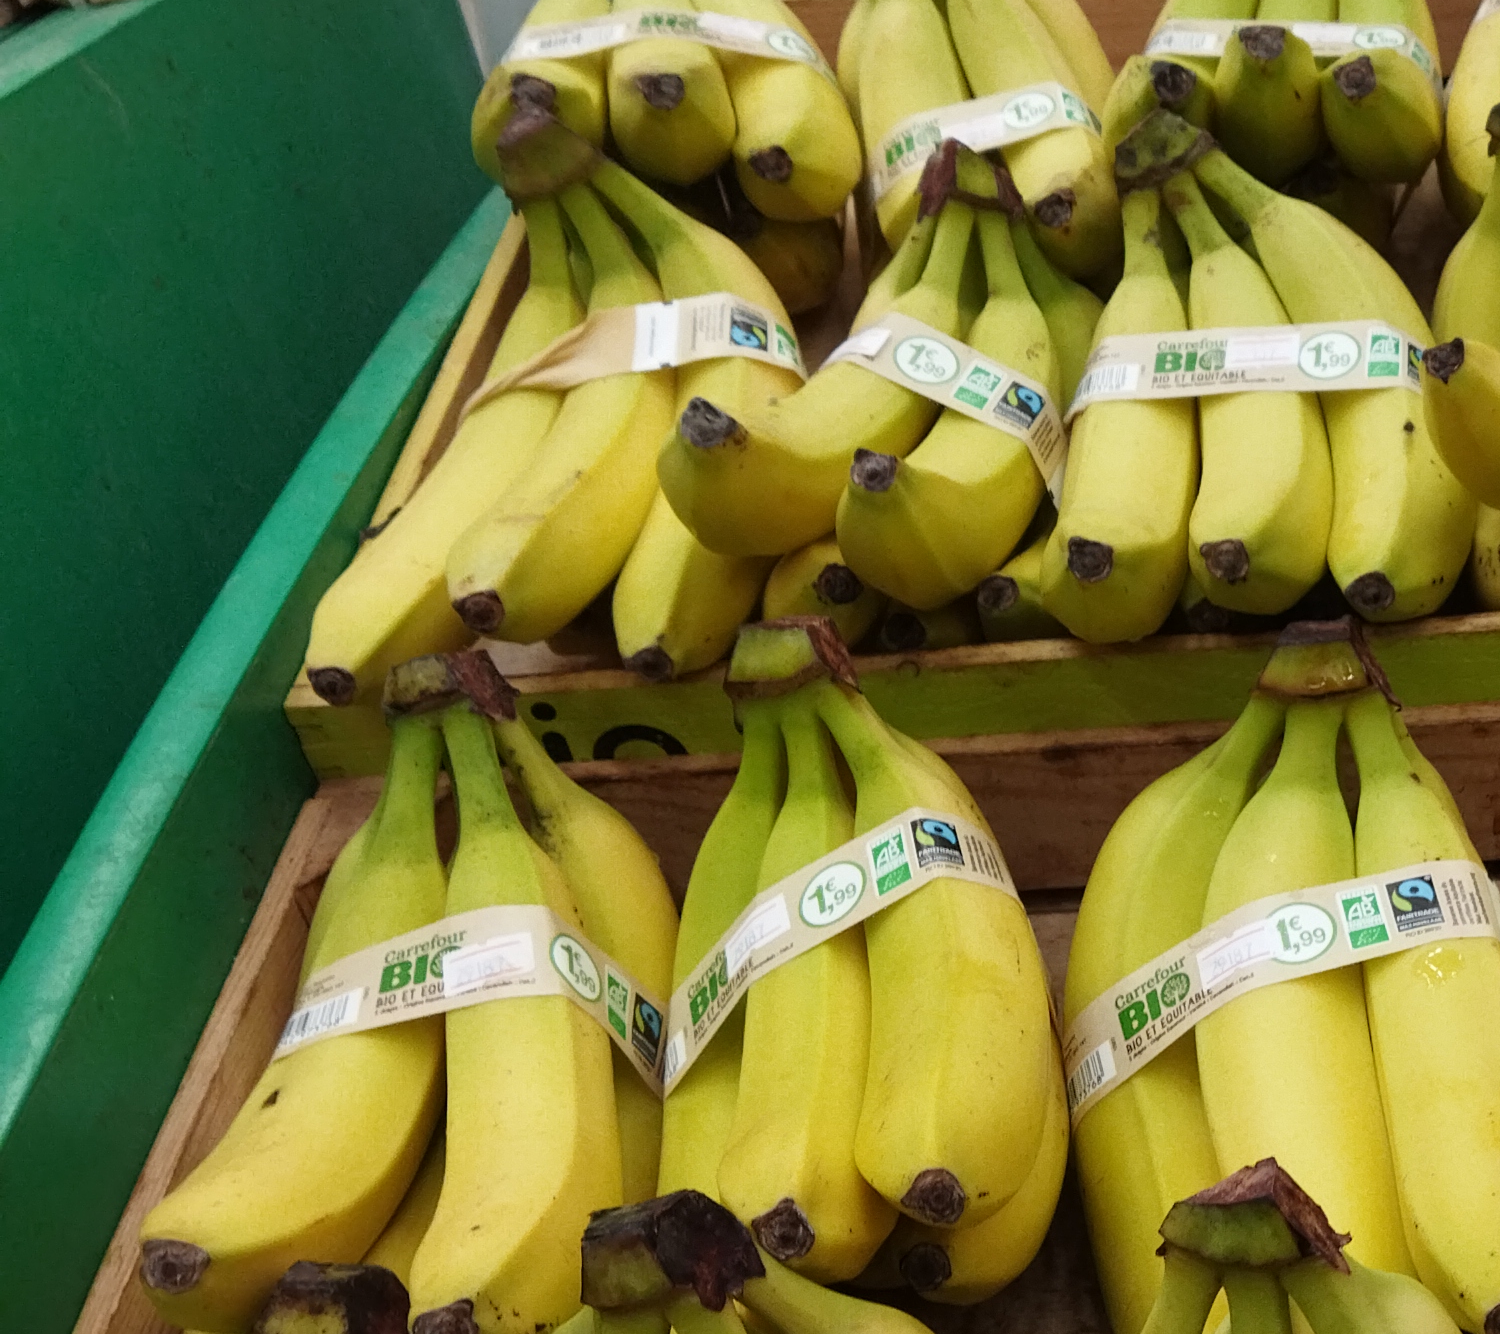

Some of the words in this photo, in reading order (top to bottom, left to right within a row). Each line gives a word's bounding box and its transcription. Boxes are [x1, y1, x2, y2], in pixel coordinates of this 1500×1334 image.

[1154, 349, 1227, 373] BIO
[384, 928, 468, 964] Carrefour
[1114, 956, 1186, 1010] Carrefour
[1118, 972, 1191, 1041] BIO
[1126, 1037, 1143, 1055] BIO
[1146, 1024, 1157, 1040] ET
[1160, 988, 1213, 1028] EQUITABLE
